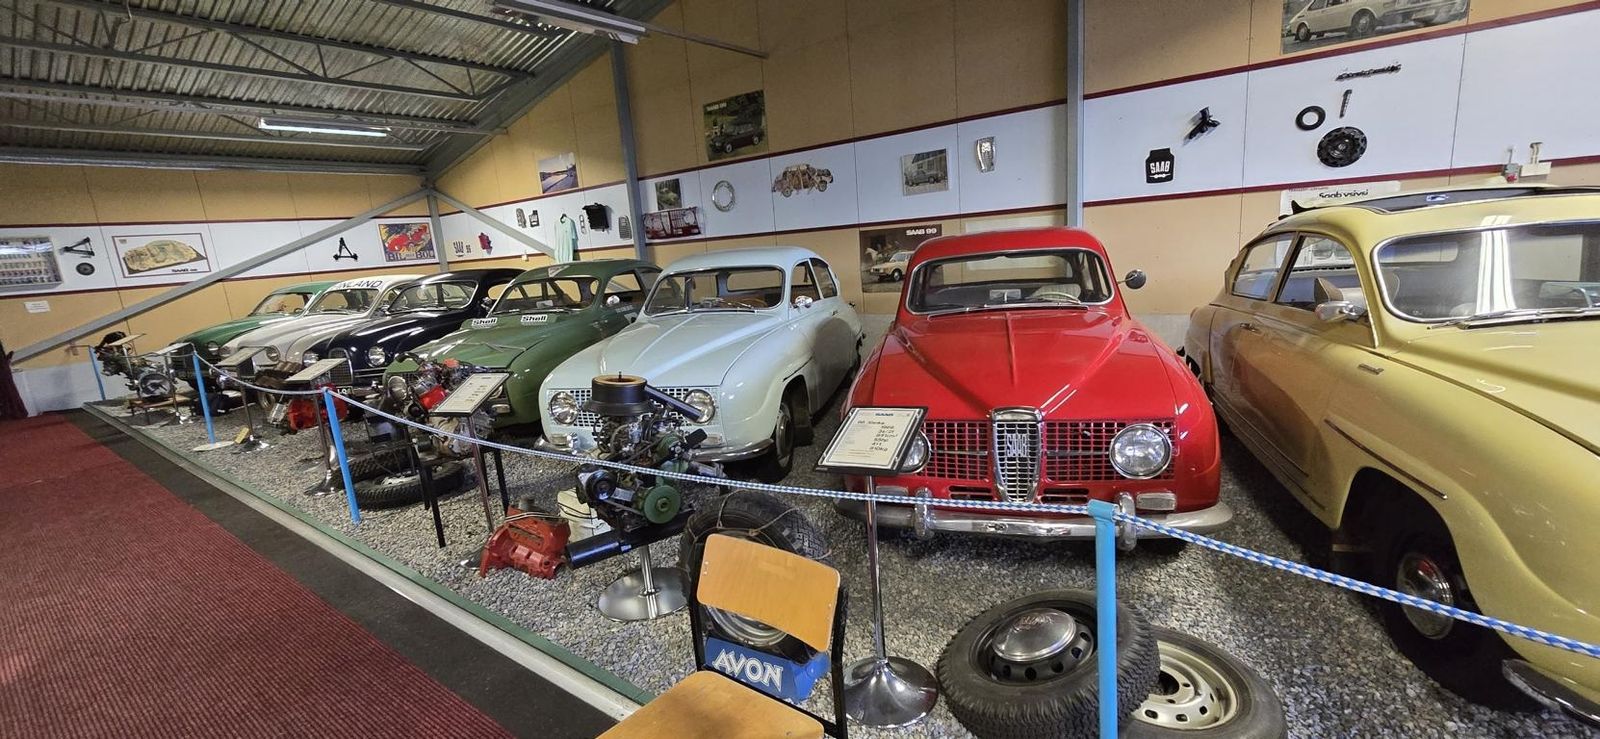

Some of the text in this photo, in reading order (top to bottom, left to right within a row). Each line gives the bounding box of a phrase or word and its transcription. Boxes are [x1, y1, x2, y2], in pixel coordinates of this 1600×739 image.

[1150, 161, 1171, 174] SAAB
[905, 227, 937, 236] SAAB 99
[1006, 434, 1028, 457] SAAB
[711, 648, 784, 692] AVON
